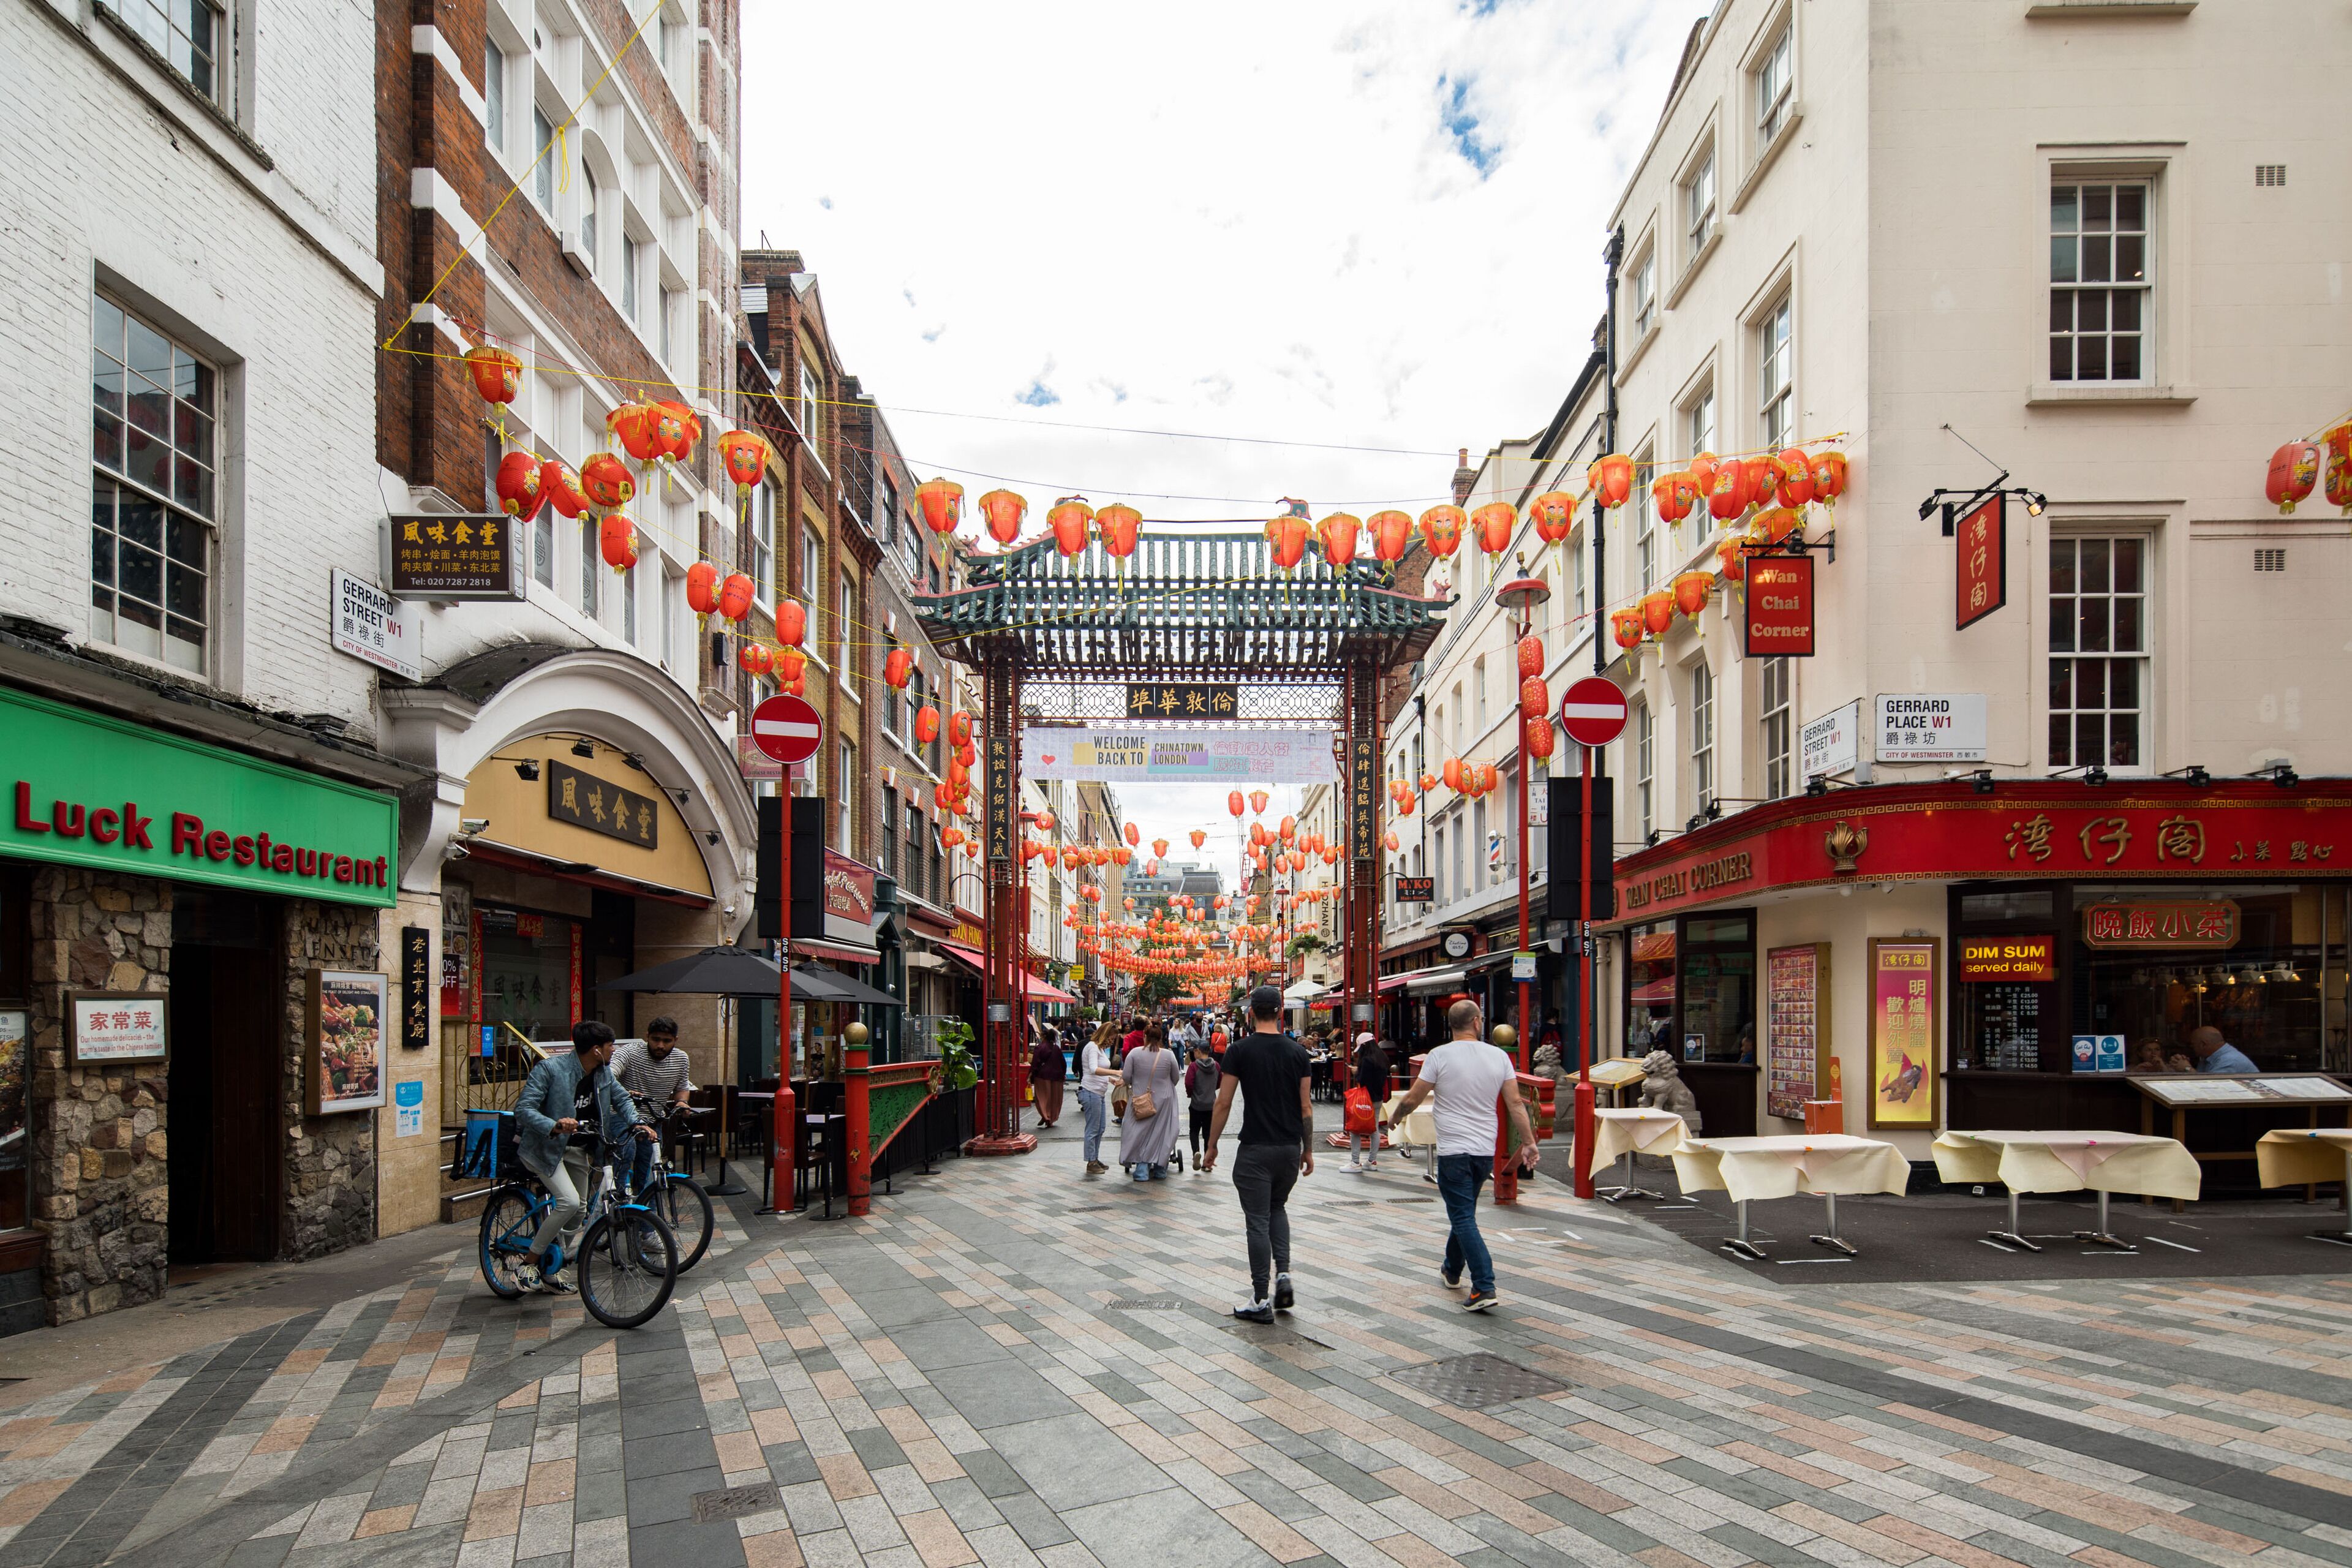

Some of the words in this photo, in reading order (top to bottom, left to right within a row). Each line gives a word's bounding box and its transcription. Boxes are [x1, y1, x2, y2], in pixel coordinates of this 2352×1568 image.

[403, 520, 499, 545] 風味食堂
[1762, 569, 1798, 584] Wan
[344, 579, 393, 616] GERRARD
[1761, 595, 1800, 610] Chai
[344, 597, 383, 628] STREET
[387, 619, 402, 638] W1
[343, 617, 385, 648] 爵祿街
[1751, 623, 1809, 638] Corner
[343, 640, 354, 650] CITY
[364, 649, 398, 670] WESTMINSTER
[1887, 700, 1950, 713] GERRARD
[1804, 718, 1835, 742] GERRARD
[1887, 716, 1927, 729] PLACE
[1932, 716, 1951, 728] W1
[1094, 736, 1145, 750] WELCOME
[1155, 742, 1204, 752] CHINATOWN
[1214, 741, 1289, 756] 倫敦唐人街
[1804, 736, 1829, 756] STREET
[1830, 730, 1841, 746] W1
[1886, 731, 1937, 745] 爵祿坊
[1098, 752, 1126, 766] BACK
[1131, 752, 1144, 766] TO
[1155, 754, 1188, 764] LONDON
[561, 776, 652, 840] 風味食堂
[15, 780, 154, 849] Luck
[173, 812, 388, 888] Restaurant
[2230, 840, 2271, 862] 小菜
[2290, 842, 2334, 862] 點心
[1625, 882, 1651, 910] WAN
[1653, 871, 1687, 903] CHAI
[1690, 852, 1753, 894] CORNER
[968, 925, 981, 946] FUNG
[2095, 910, 2228, 940] 晚飯小菜
[1965, 947, 1999, 959] DIM
[2003, 945, 2046, 959] SUM
[442, 959, 456, 973] 0%
[1966, 963, 2009, 973] served
[2013, 960, 2045, 974] daily
[411, 937, 426, 1039] 老北京食府
[89, 1011, 153, 1031] 家常菜
[1909, 979, 1927, 1049] 明爐燒臘
[1887, 997, 1905, 1065] 歡迎外賣
